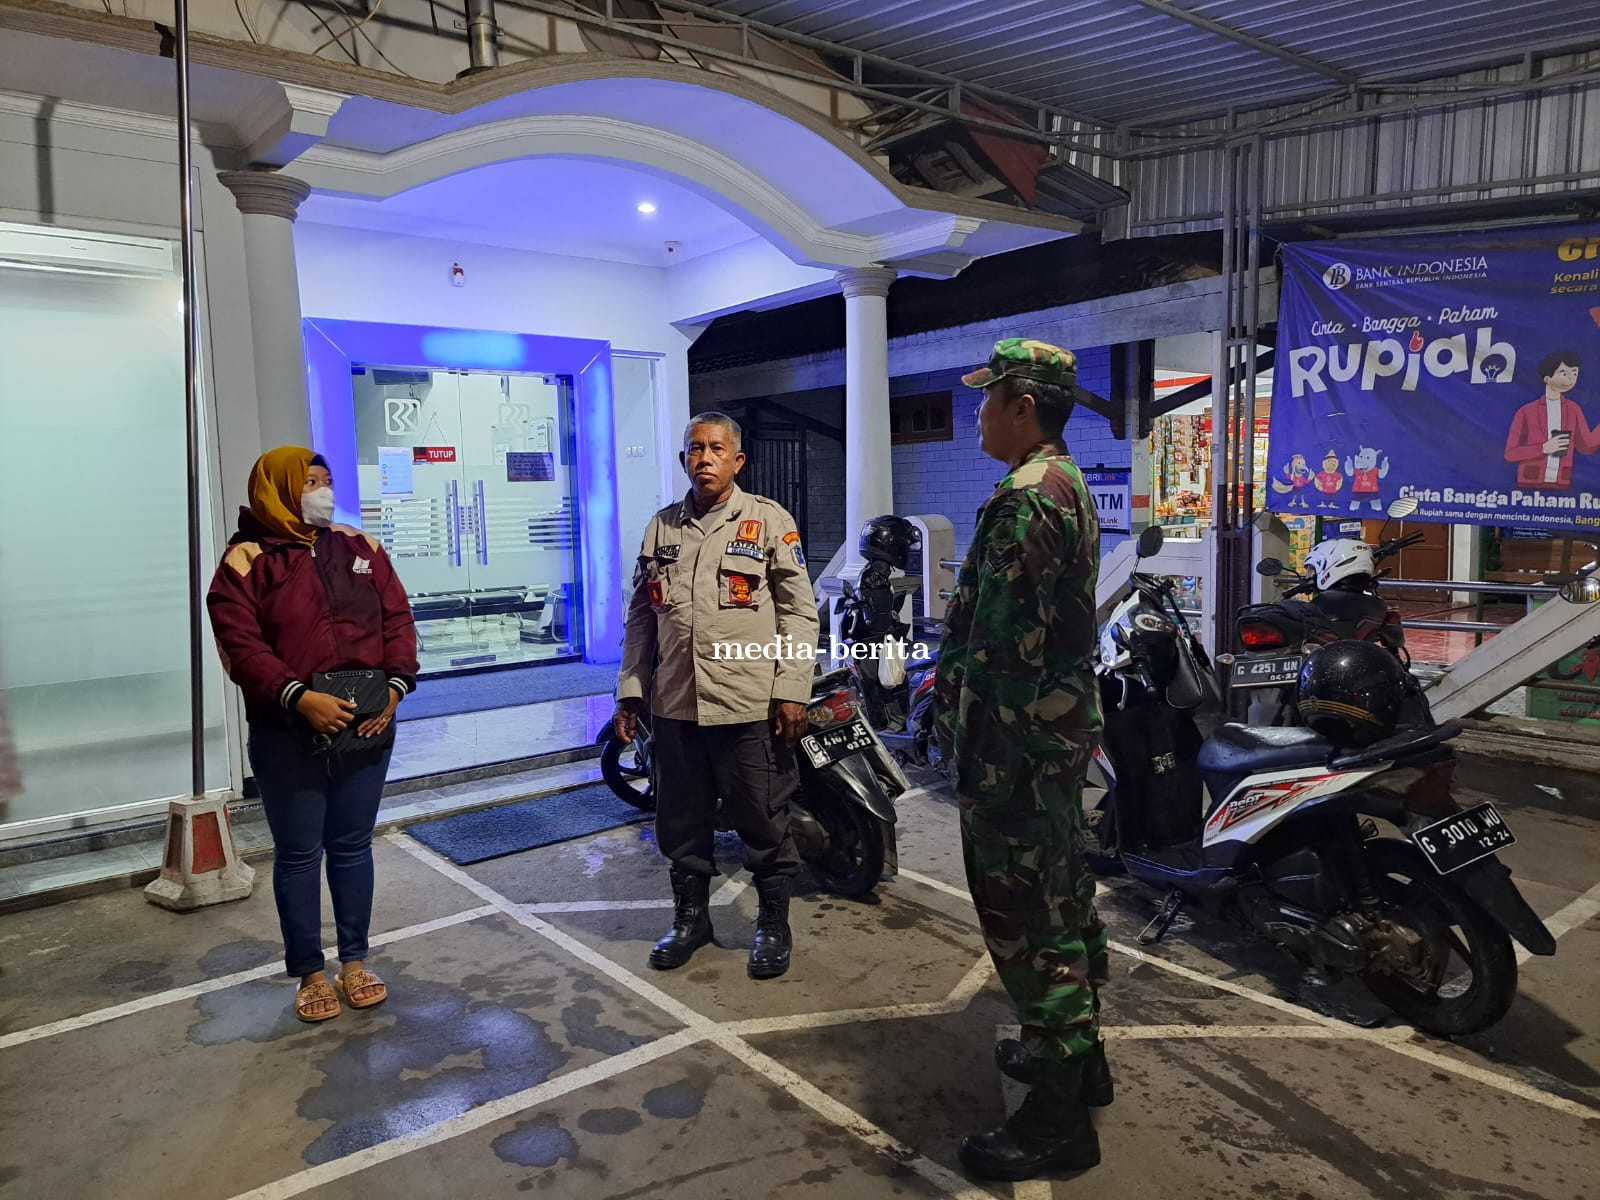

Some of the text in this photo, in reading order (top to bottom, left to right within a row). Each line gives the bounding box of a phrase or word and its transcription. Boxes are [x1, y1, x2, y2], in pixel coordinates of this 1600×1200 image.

[1355, 255, 1489, 281] BANK INDONESIA
[1406, 275, 1440, 284] REPUBLIK
[1442, 271, 1487, 281] INDONESIA
[1553, 268, 1600, 283] Kenali
[1311, 305, 1498, 336] Cinta Bangga Paham
[1289, 327, 1516, 398] Rupiah
[428, 450, 454, 459] TUTUP
[1399, 484, 1440, 502] Cinta
[1443, 487, 1508, 508] Bangga
[1511, 490, 1576, 508] Paham
[1419, 508, 1444, 518] Rupiah
[1444, 510, 1464, 518] sama
[1464, 510, 1493, 520] dengan
[1494, 511, 1531, 521] mencinta
[1531, 513, 1574, 524] Indonesia,
[1237, 665, 1245, 675] G
[809, 738, 820, 753] G
[851, 723, 867, 737] JE
[1421, 836, 1437, 854] G
[1441, 818, 1479, 845] 3010
